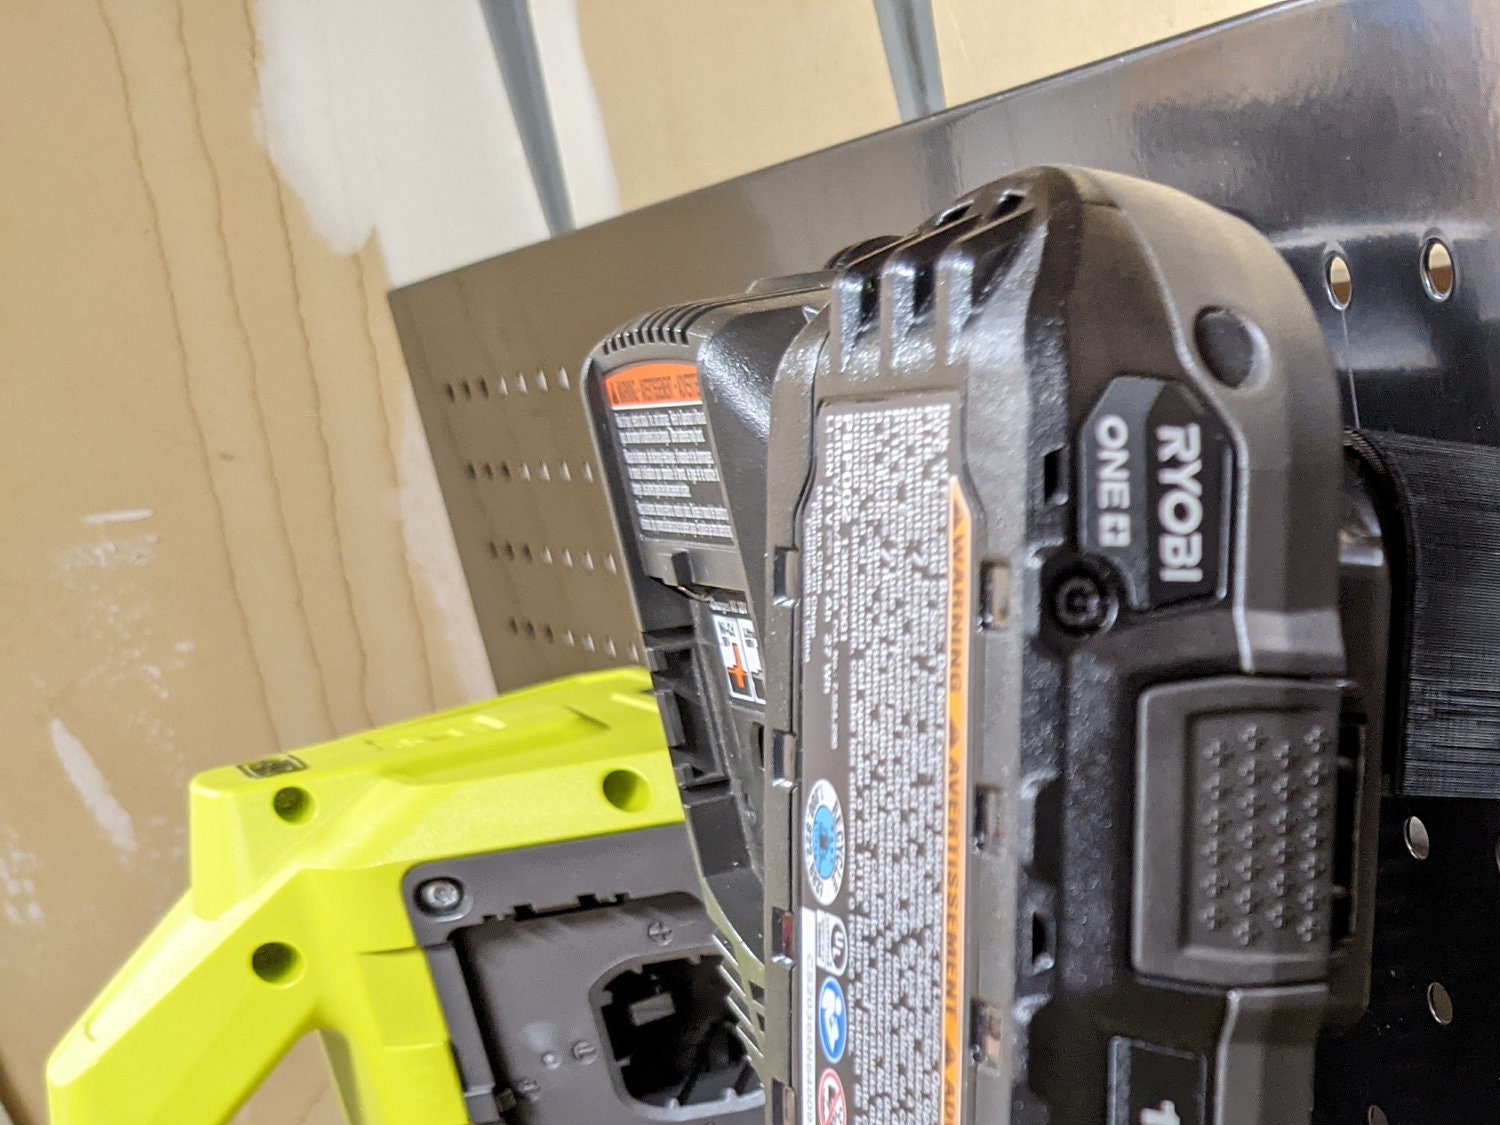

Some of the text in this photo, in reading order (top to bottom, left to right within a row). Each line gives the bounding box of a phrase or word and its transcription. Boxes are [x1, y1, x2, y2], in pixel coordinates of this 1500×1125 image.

[841, 413, 852, 523] PBP002
[1156, 423, 1203, 582] RYOBI
[950, 536, 964, 692] WARNING
[946, 756, 960, 1018] AVERTISSEMENT
